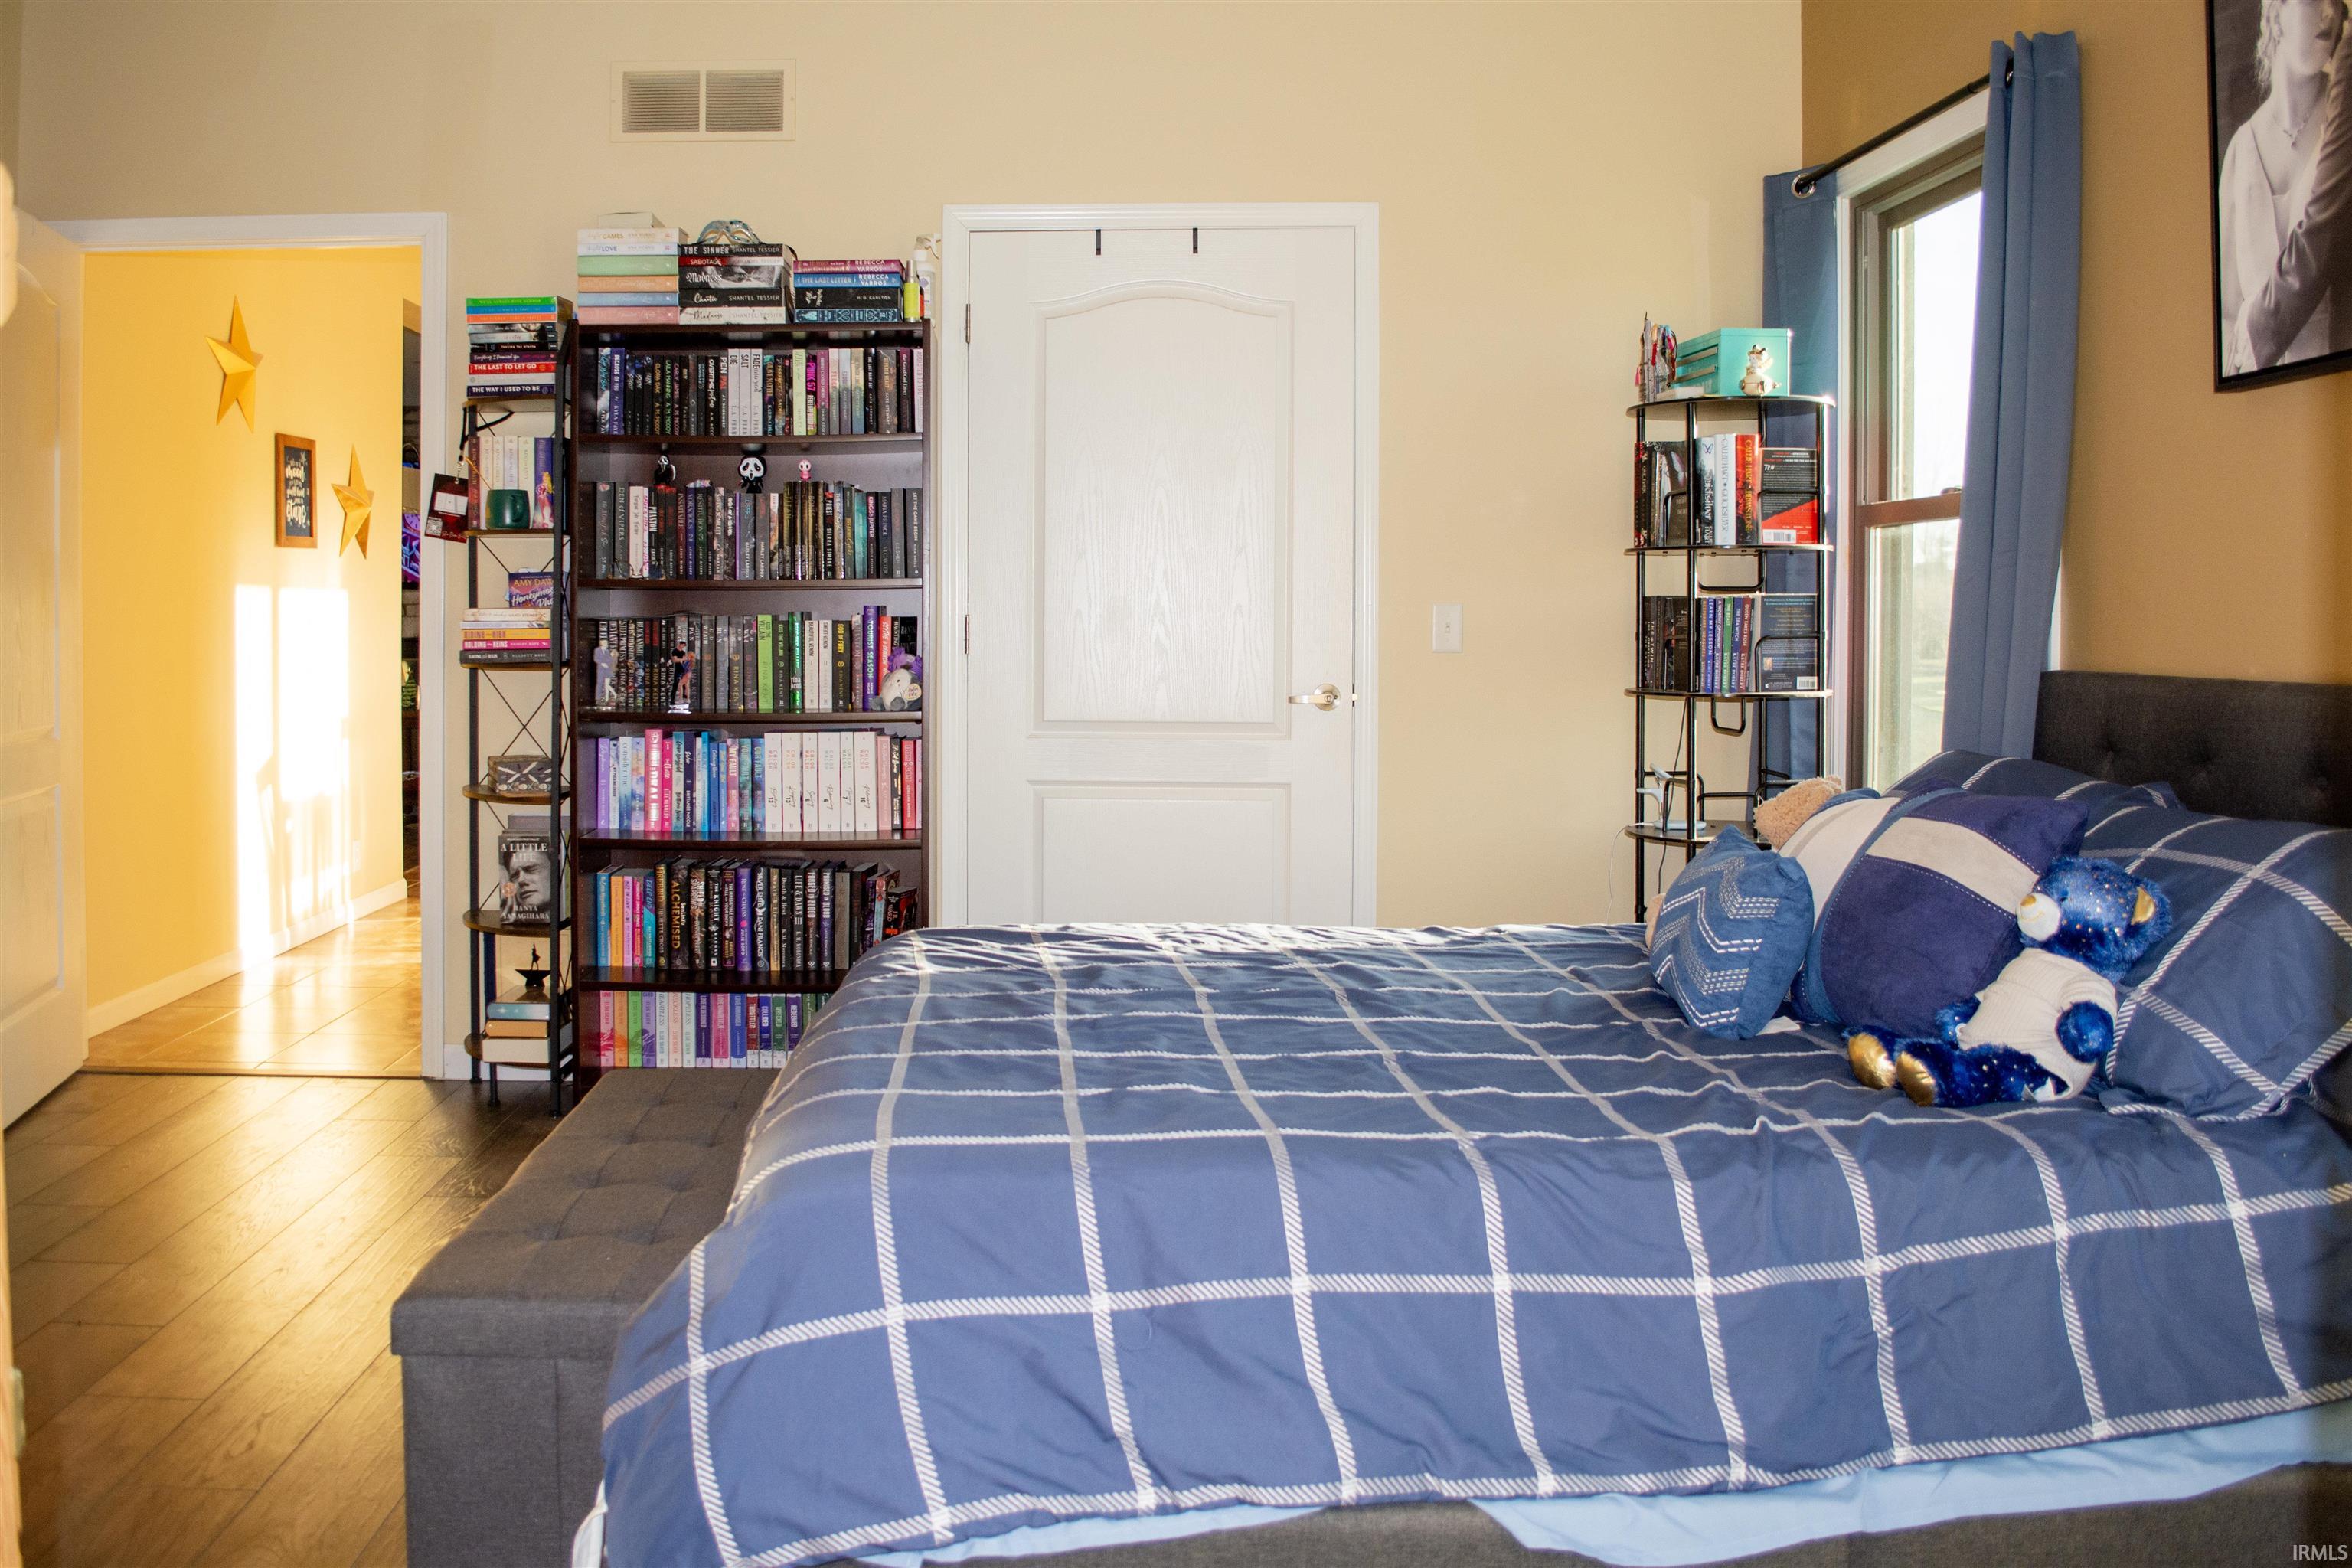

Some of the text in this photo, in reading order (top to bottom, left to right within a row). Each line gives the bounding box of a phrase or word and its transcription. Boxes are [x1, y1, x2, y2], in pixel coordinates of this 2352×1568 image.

[686, 273, 722, 283] Madness
[730, 355, 738, 364] DIG
[807, 362, 815, 381] PUNK
[807, 382, 815, 391] 57
[1708, 620, 1713, 629] MY
[729, 747, 737, 758] MY
[754, 760, 763, 778] FAULT
[501, 843, 547, 851] A LITTLE
[656, 867, 665, 901] FIREBIRD
[671, 880, 680, 949] ALCHEMISED
